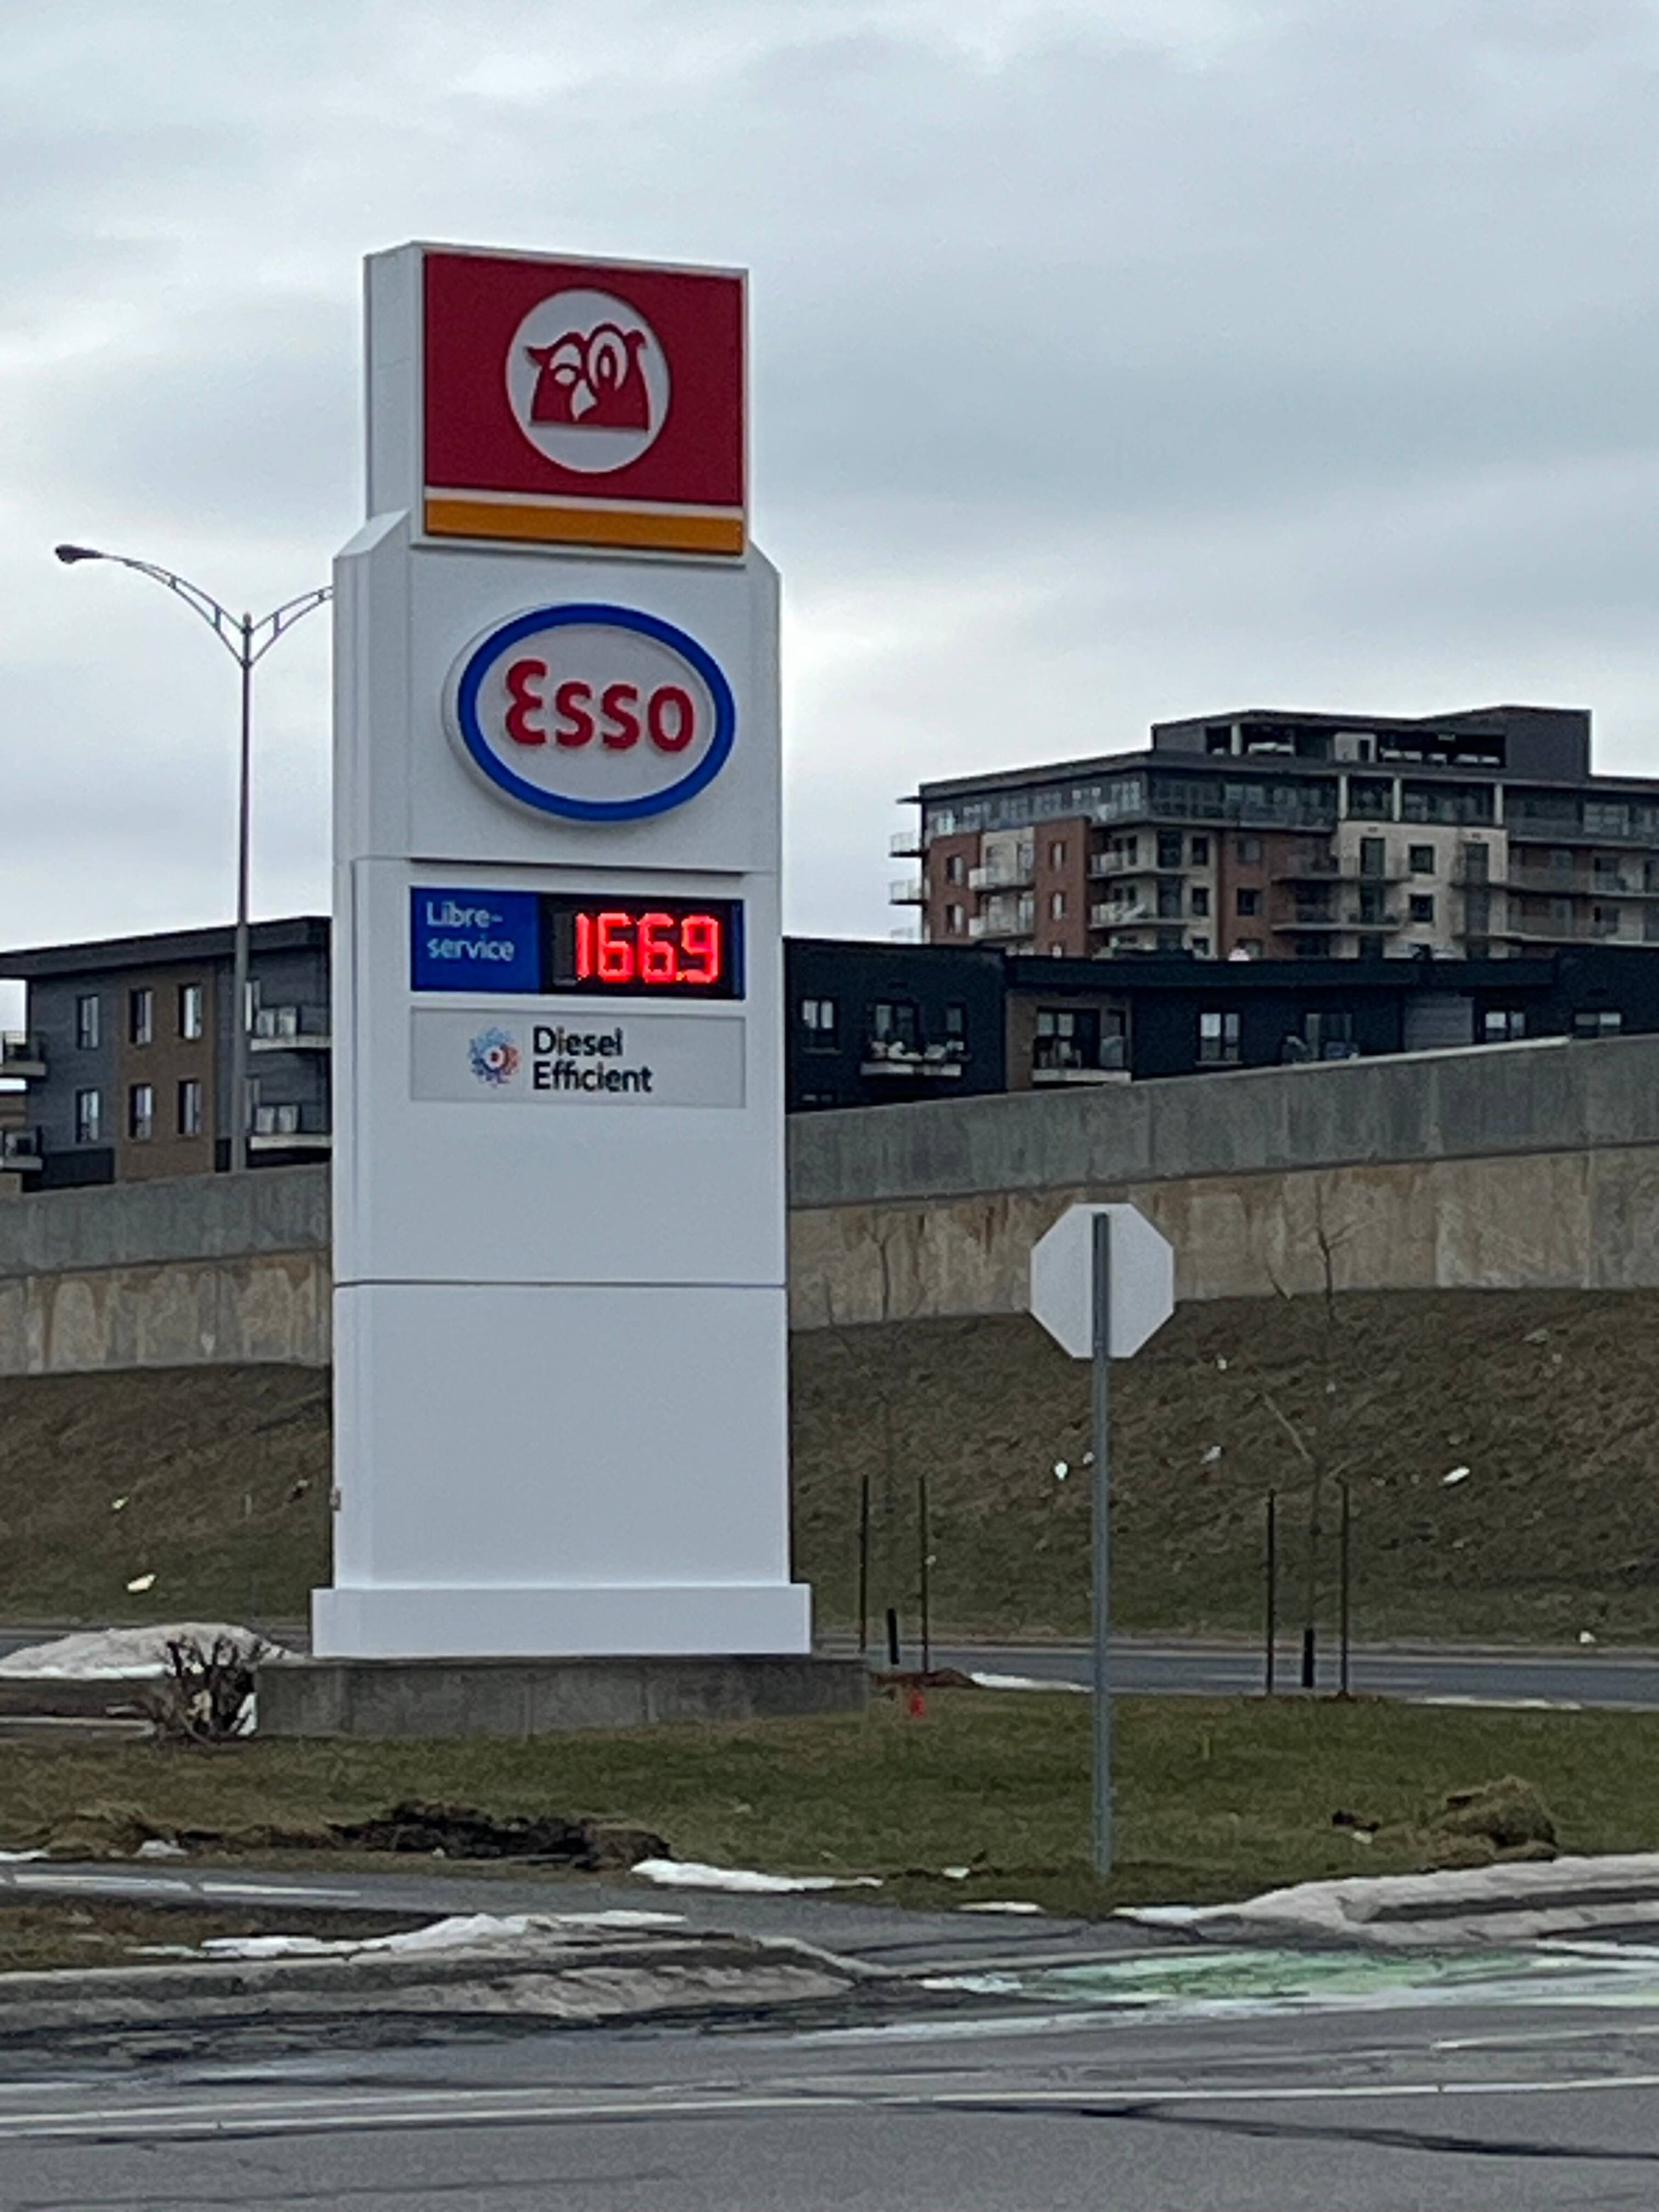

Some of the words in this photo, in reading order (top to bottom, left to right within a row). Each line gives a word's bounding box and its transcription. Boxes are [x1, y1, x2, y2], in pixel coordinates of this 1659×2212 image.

[426, 901, 503, 928] Libre-
[426, 935, 515, 962] service
[533, 1026, 623, 1057] Diesel
[533, 1059, 653, 1093] Efficient
